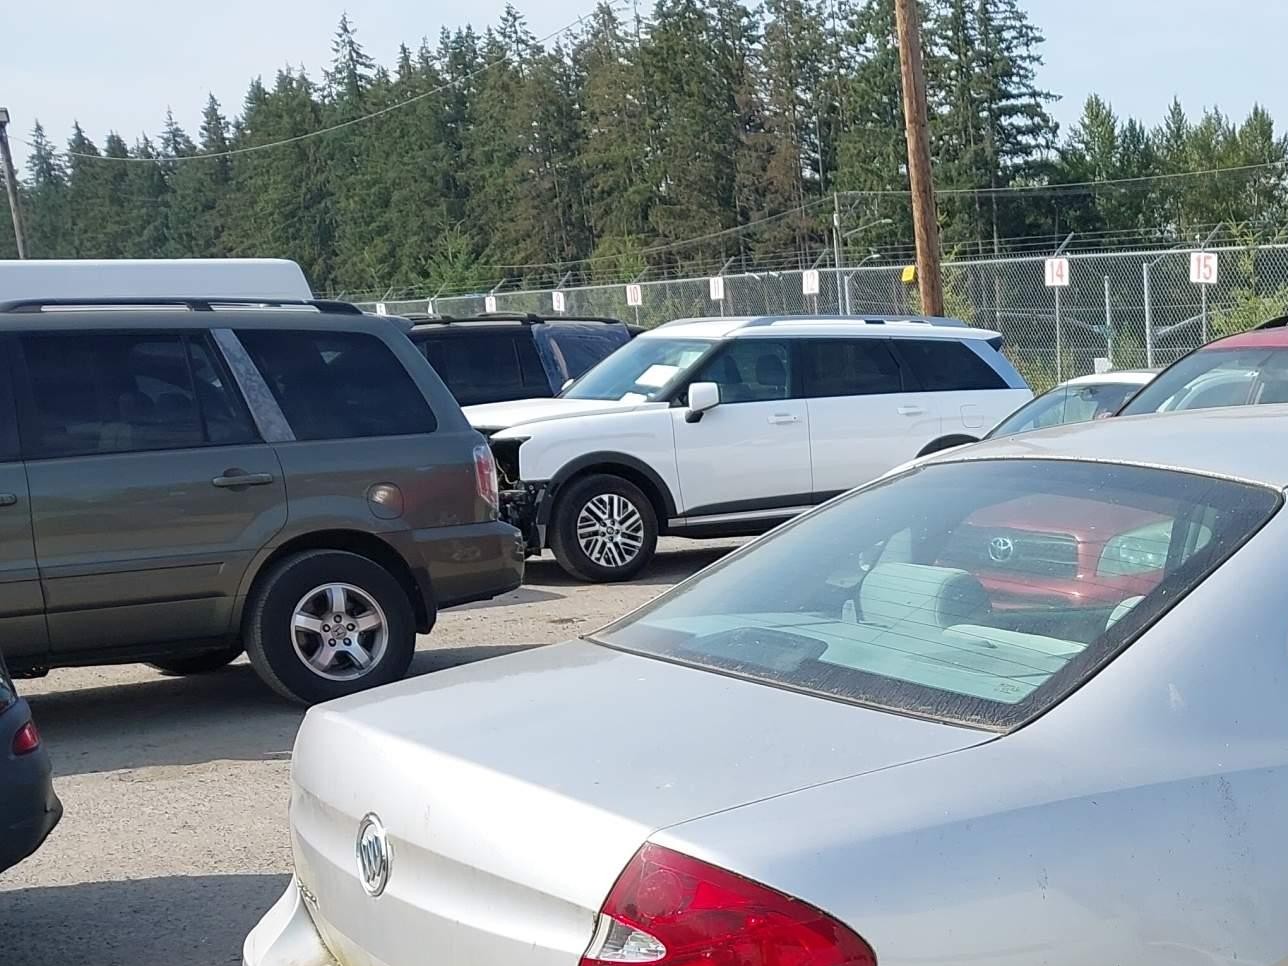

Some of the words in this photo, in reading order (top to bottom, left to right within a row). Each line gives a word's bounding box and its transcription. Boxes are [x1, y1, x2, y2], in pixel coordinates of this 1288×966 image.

[1050, 261, 1065, 284] 14
[1195, 255, 1213, 281] 15
[713, 279, 721, 296] 11
[806, 270, 816, 292] 12
[629, 286, 639, 303] 10
